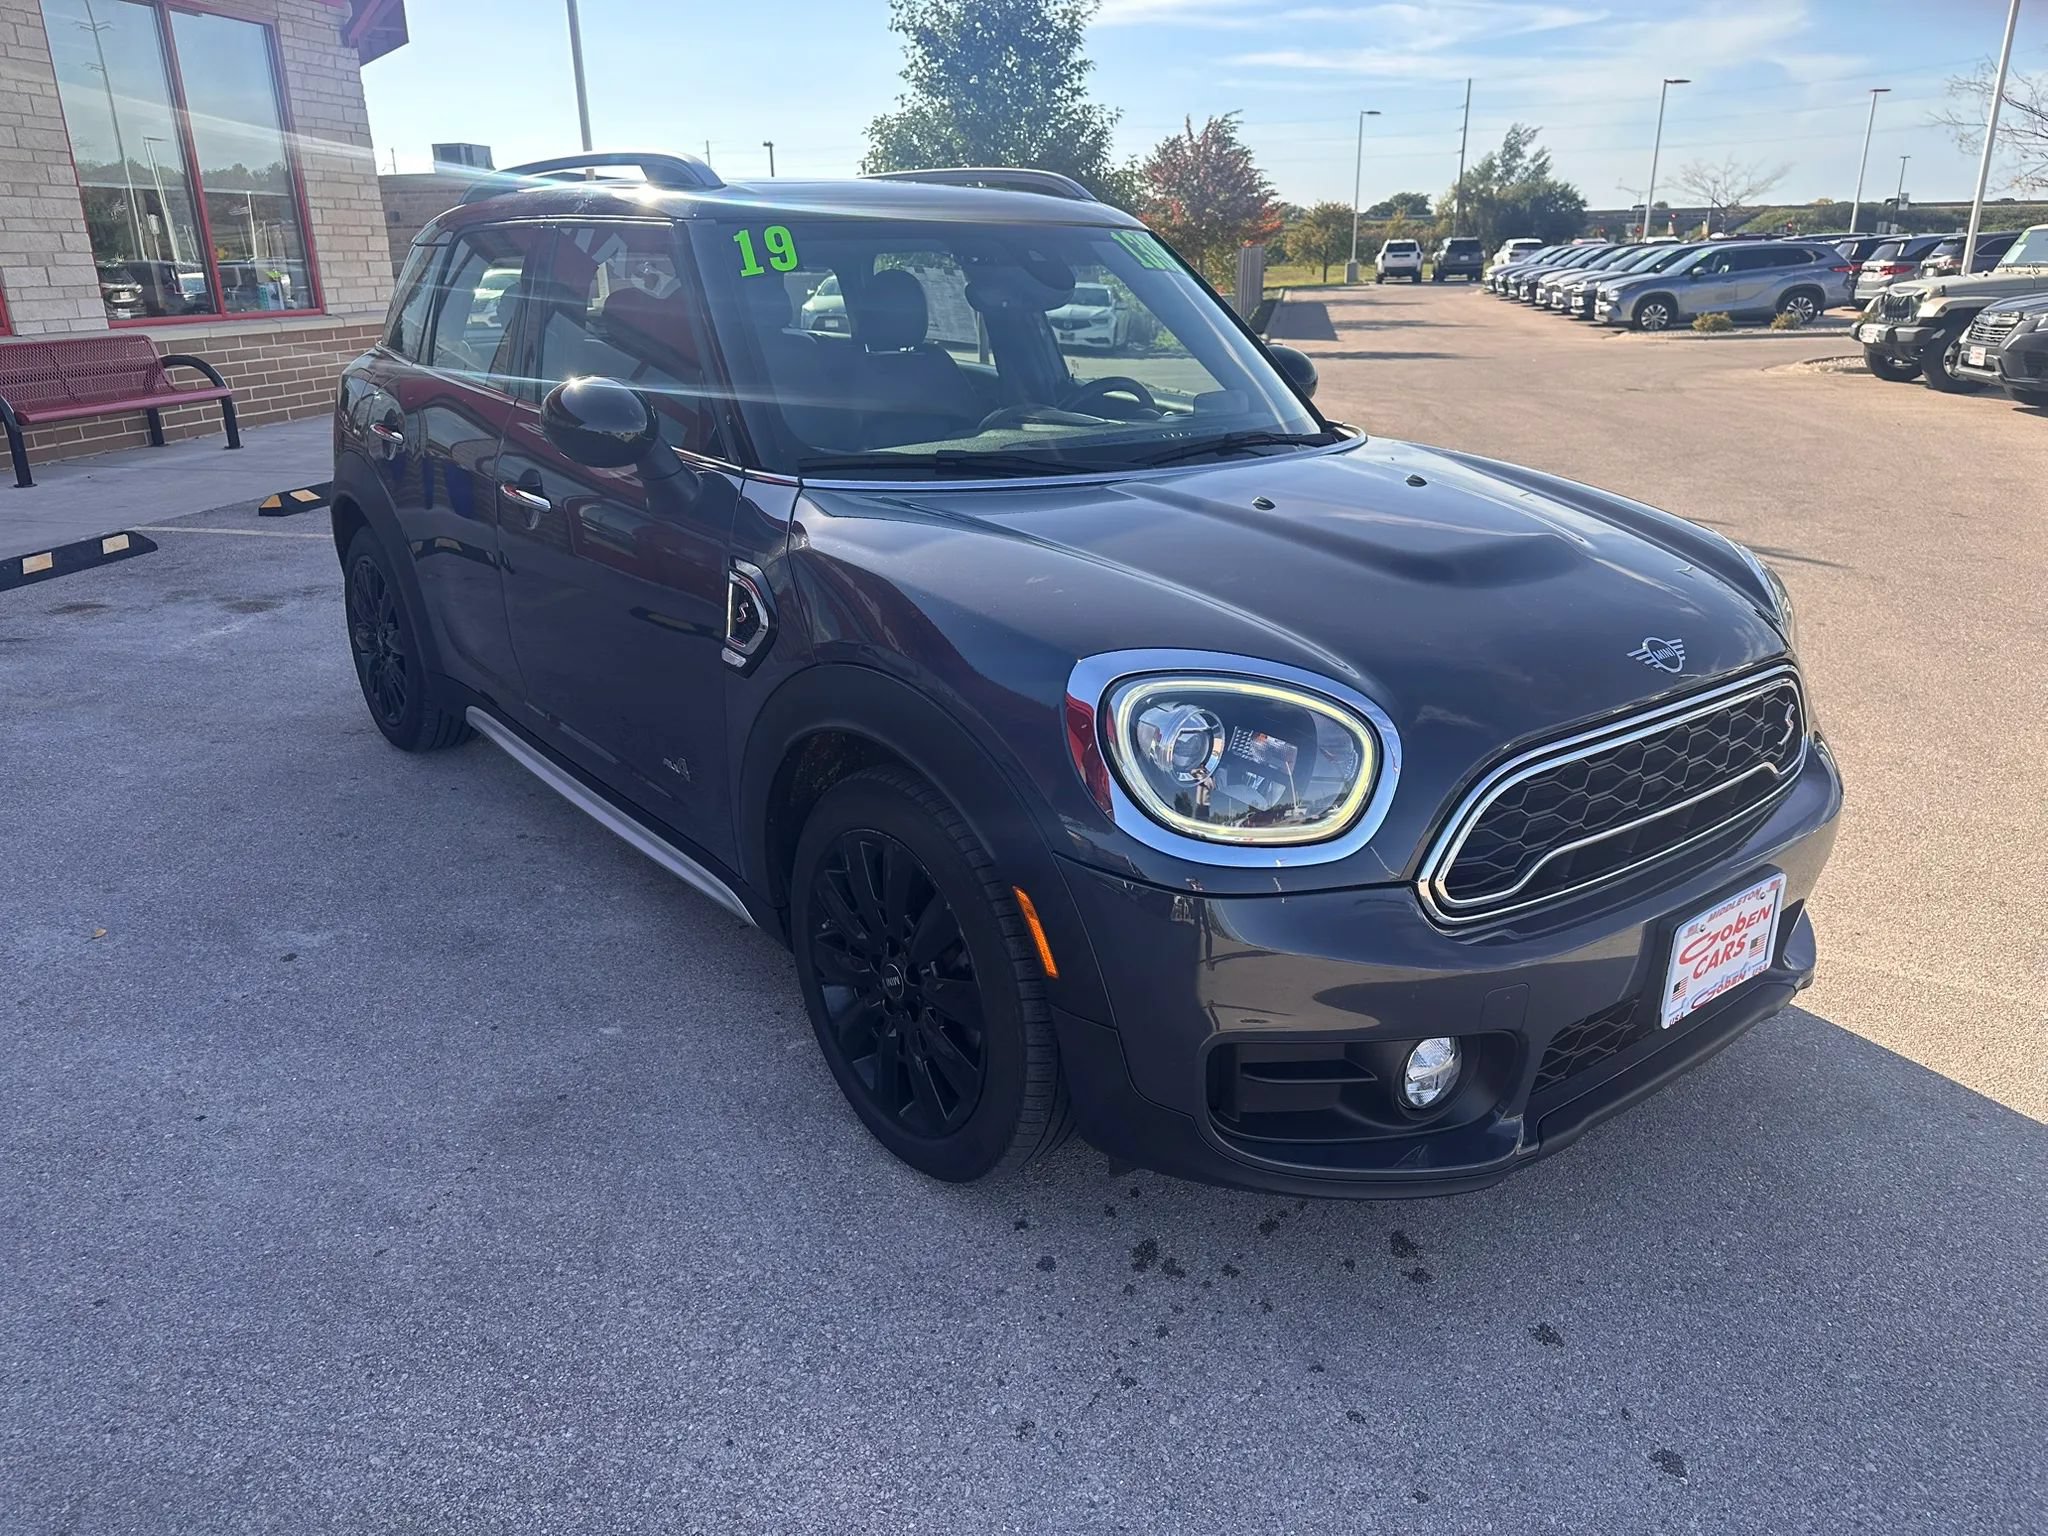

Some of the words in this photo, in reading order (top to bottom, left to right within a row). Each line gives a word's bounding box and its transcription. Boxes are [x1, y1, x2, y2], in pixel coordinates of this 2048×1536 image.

[733, 225, 798, 277] 19
[1652, 647, 1676, 660] MINI
[1707, 887, 1762, 922] MIDDLETON
[1692, 934, 1749, 980] CARS
